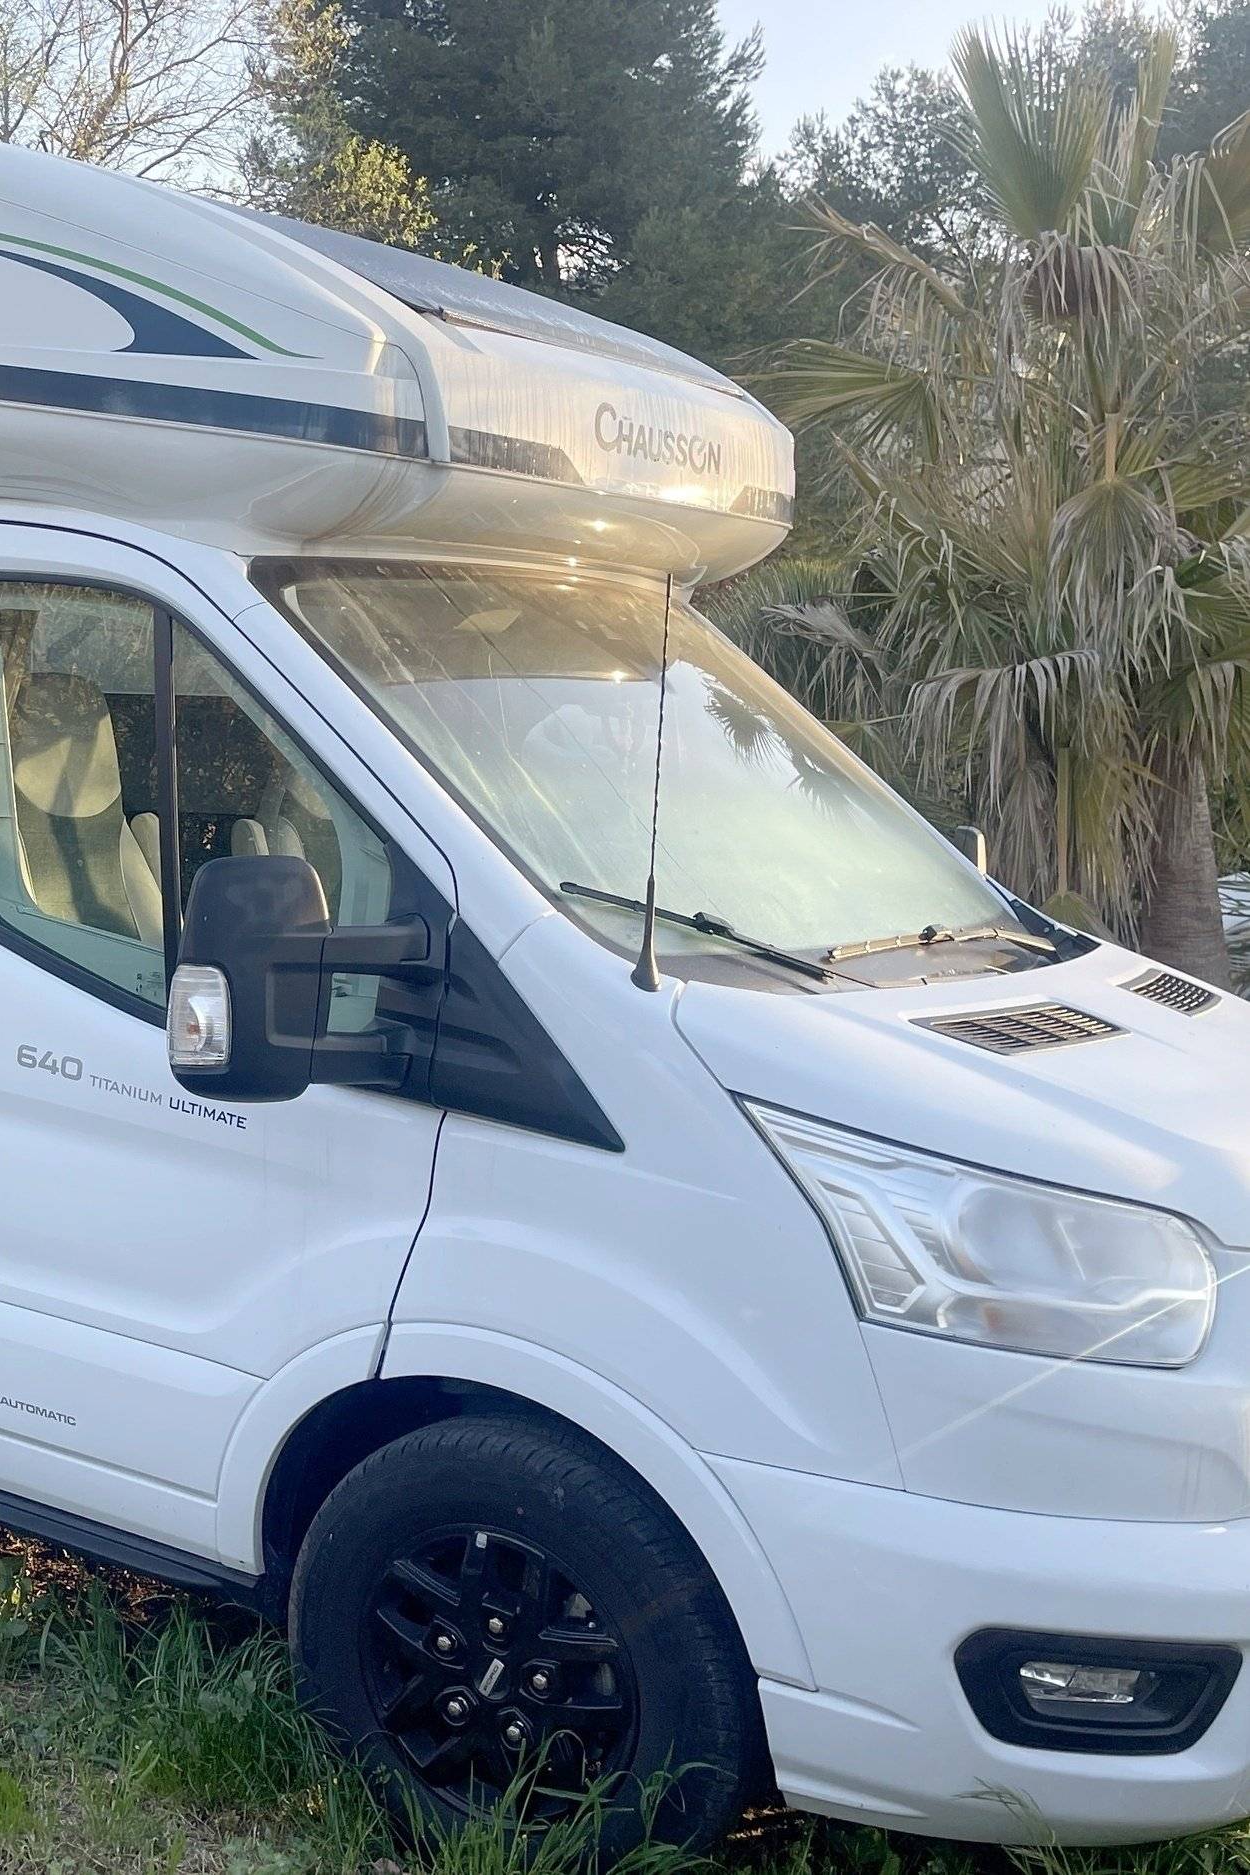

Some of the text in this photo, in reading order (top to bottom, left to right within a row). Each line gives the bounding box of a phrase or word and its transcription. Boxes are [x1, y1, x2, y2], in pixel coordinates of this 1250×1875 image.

[16, 1044, 248, 1130] 640 TITANIUM ULTIMATE
[0, 1396, 77, 1426] AUTOMATIC
